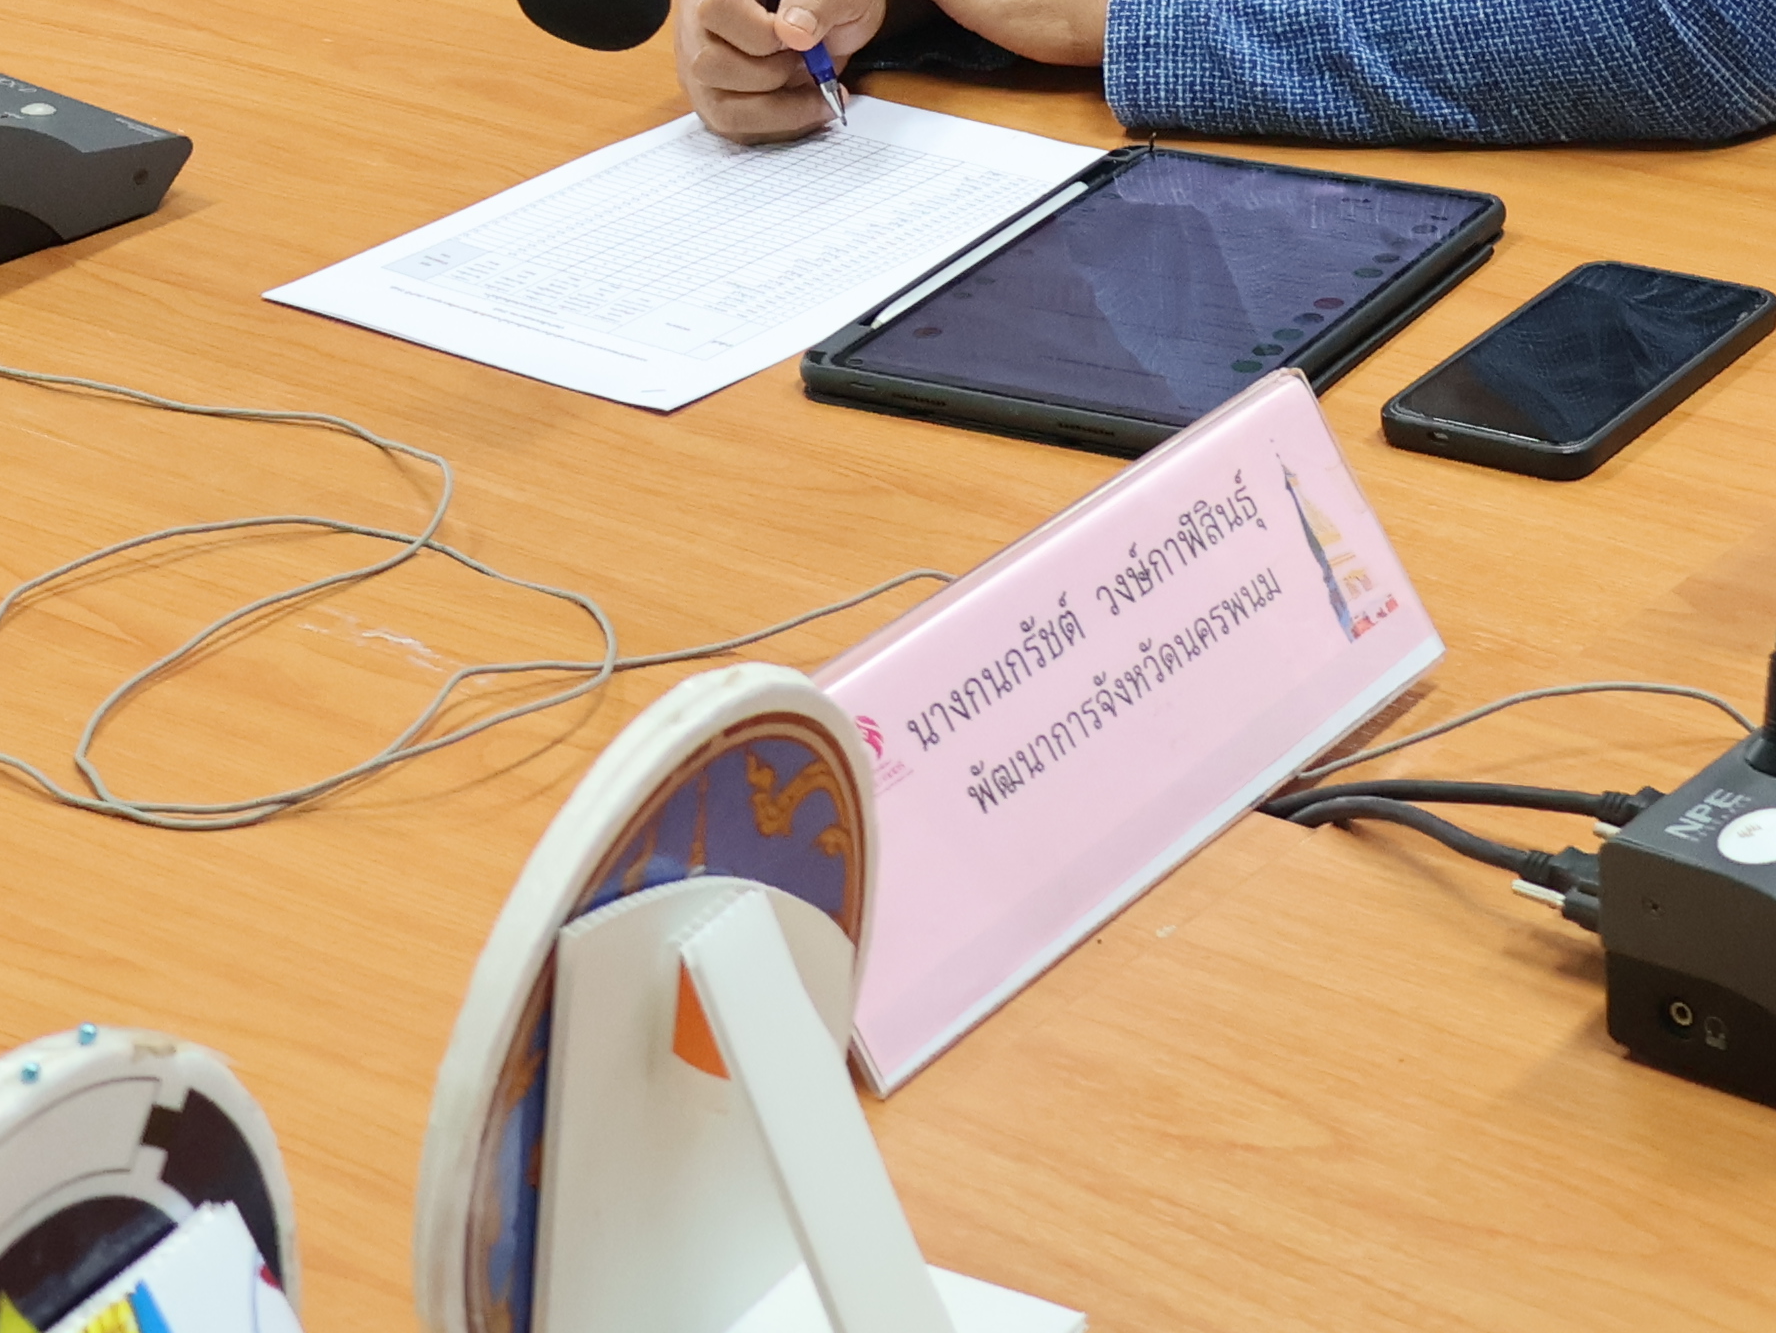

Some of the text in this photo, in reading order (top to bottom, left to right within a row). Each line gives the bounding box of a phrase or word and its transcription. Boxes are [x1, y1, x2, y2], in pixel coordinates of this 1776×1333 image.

[967, 566, 1283, 814] พัฒนาการจังหวัดนครพนม
[1665, 787, 1742, 843] NPE
